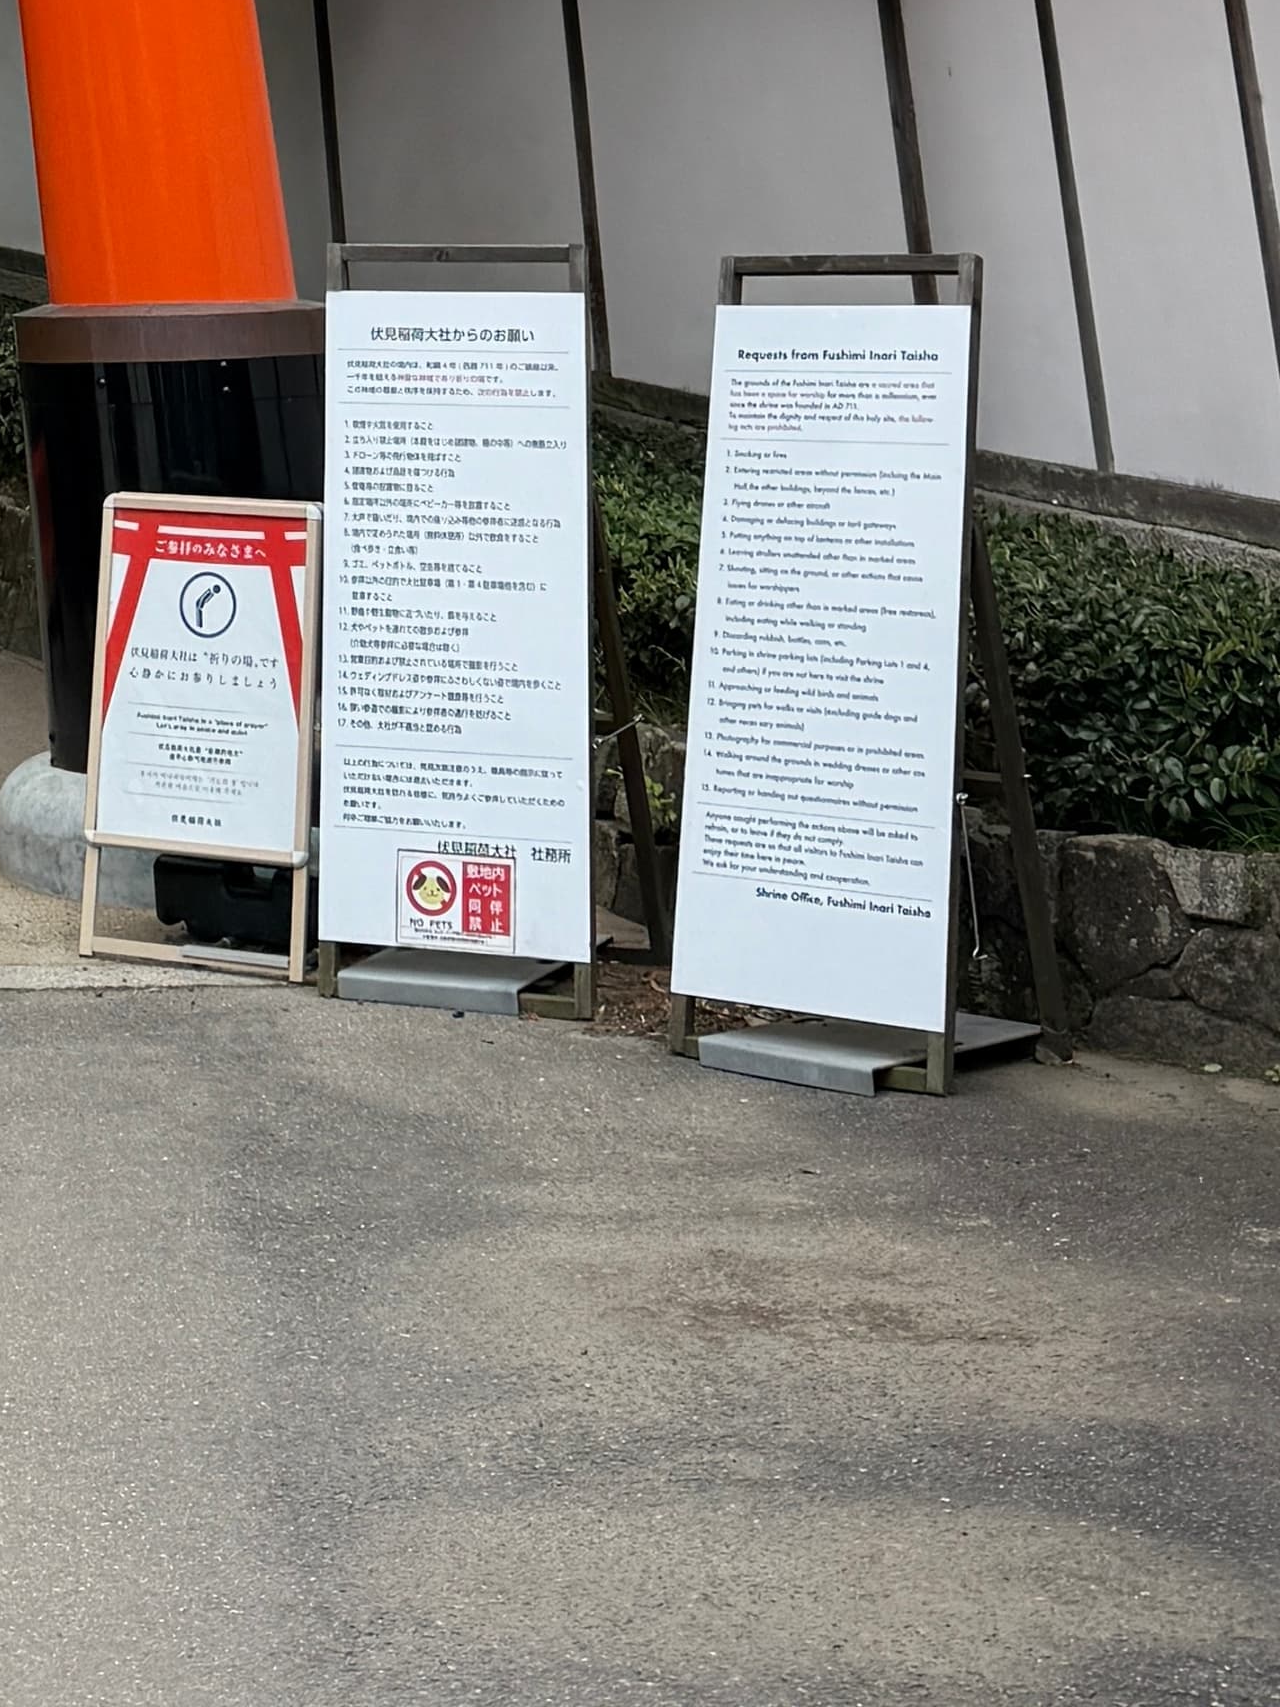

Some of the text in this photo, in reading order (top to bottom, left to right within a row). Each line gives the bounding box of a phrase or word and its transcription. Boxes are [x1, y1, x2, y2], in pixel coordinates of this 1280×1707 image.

[370, 326, 535, 343] 伏見稲荷大社からのお願い
[737, 348, 939, 363] Requests from Fushimi Inari Taisha
[155, 540, 266, 559] ご参拝のみなさまへ
[467, 863, 505, 881] 敷地内
[469, 883, 502, 897] ペット
[755, 886, 789, 901] Shrine
[826, 895, 867, 911] Fushimi
[868, 900, 895, 914] Inari
[896, 903, 932, 919] Taisha
[409, 917, 453, 931] NO PETS
